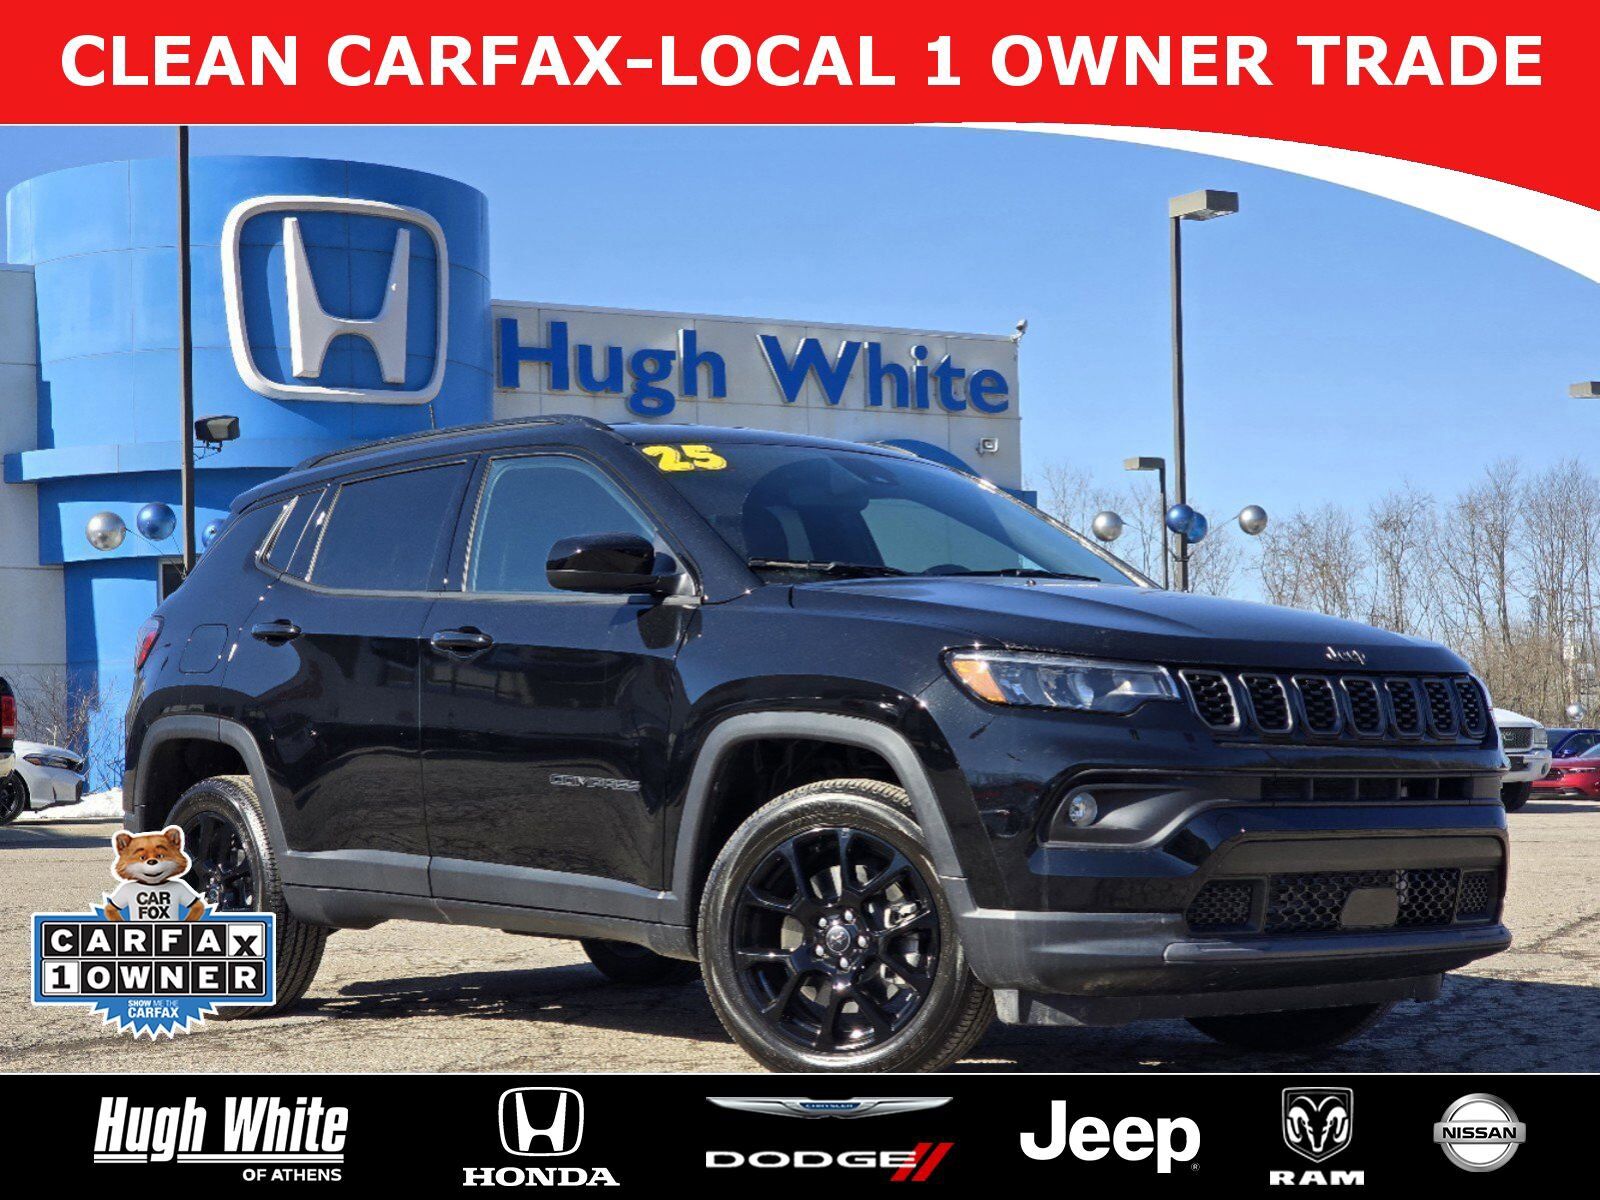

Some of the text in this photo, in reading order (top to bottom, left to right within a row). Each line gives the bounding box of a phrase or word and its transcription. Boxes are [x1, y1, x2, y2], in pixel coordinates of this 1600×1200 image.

[496, 317, 1009, 417] Hugh White
[642, 444, 727, 472] 25
